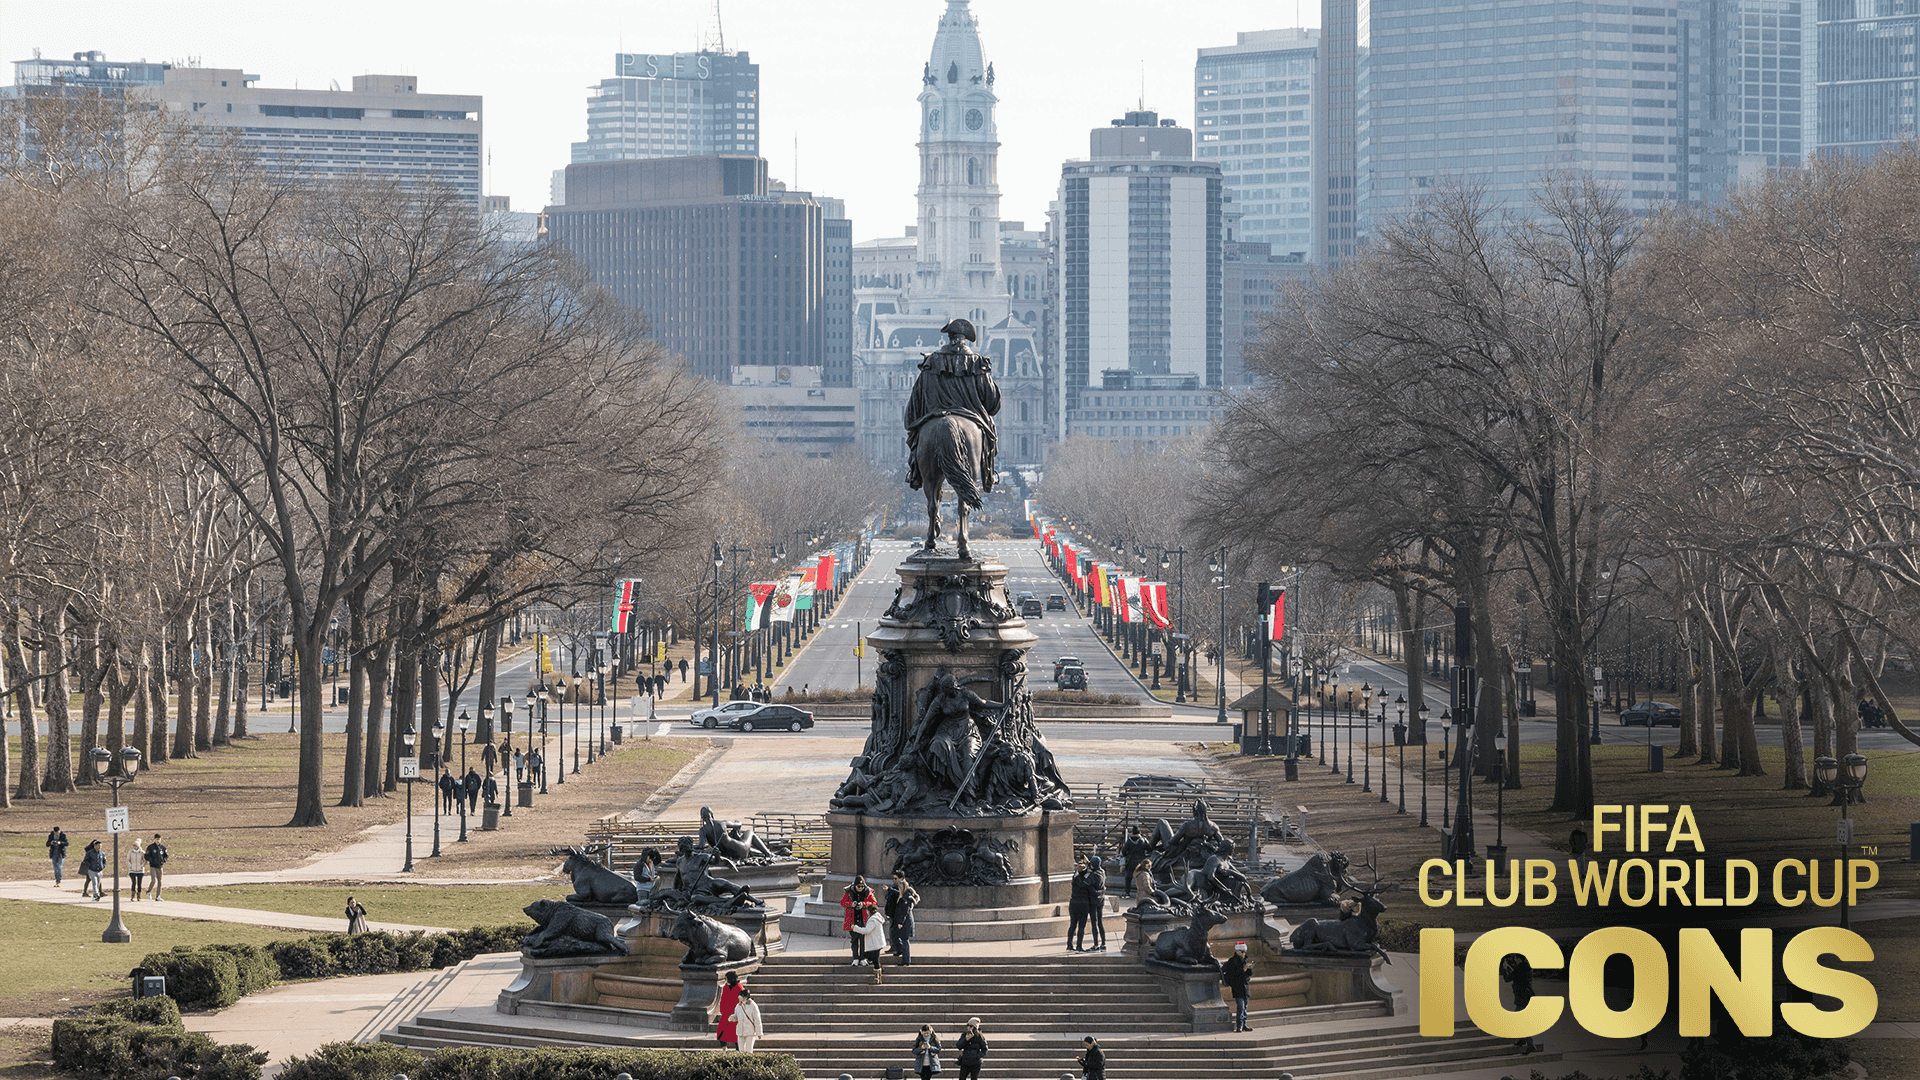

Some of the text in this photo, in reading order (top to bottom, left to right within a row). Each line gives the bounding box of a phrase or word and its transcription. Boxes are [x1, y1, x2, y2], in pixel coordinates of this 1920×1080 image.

[622, 53, 709, 79] PSFS
[403, 766, 415, 775] D-1
[112, 818, 124, 830] C-1
